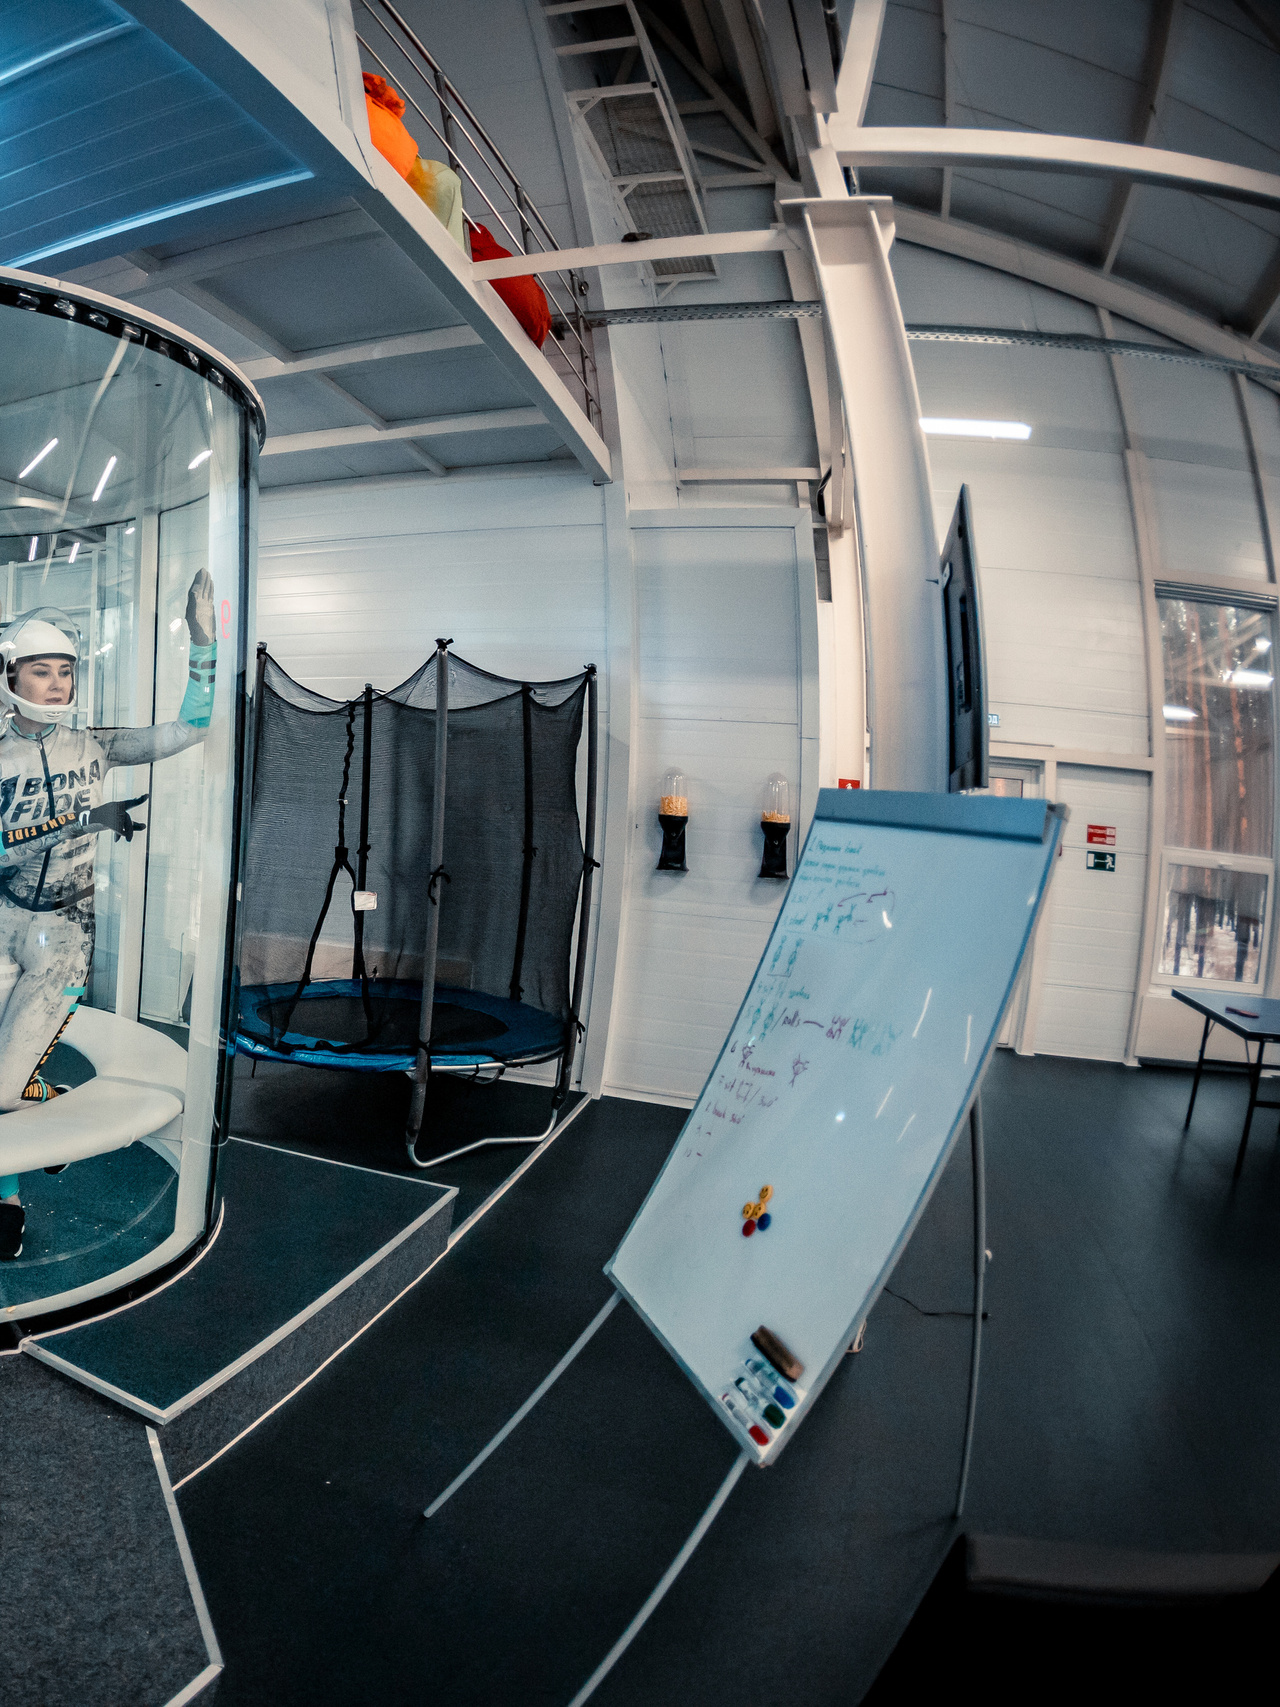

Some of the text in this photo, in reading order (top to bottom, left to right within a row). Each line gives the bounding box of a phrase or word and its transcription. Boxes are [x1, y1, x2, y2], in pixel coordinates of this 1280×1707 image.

[22, 759, 101, 797] BONA
[10, 789, 91, 822] FIDE
[8, 827, 37, 843] FIDE
